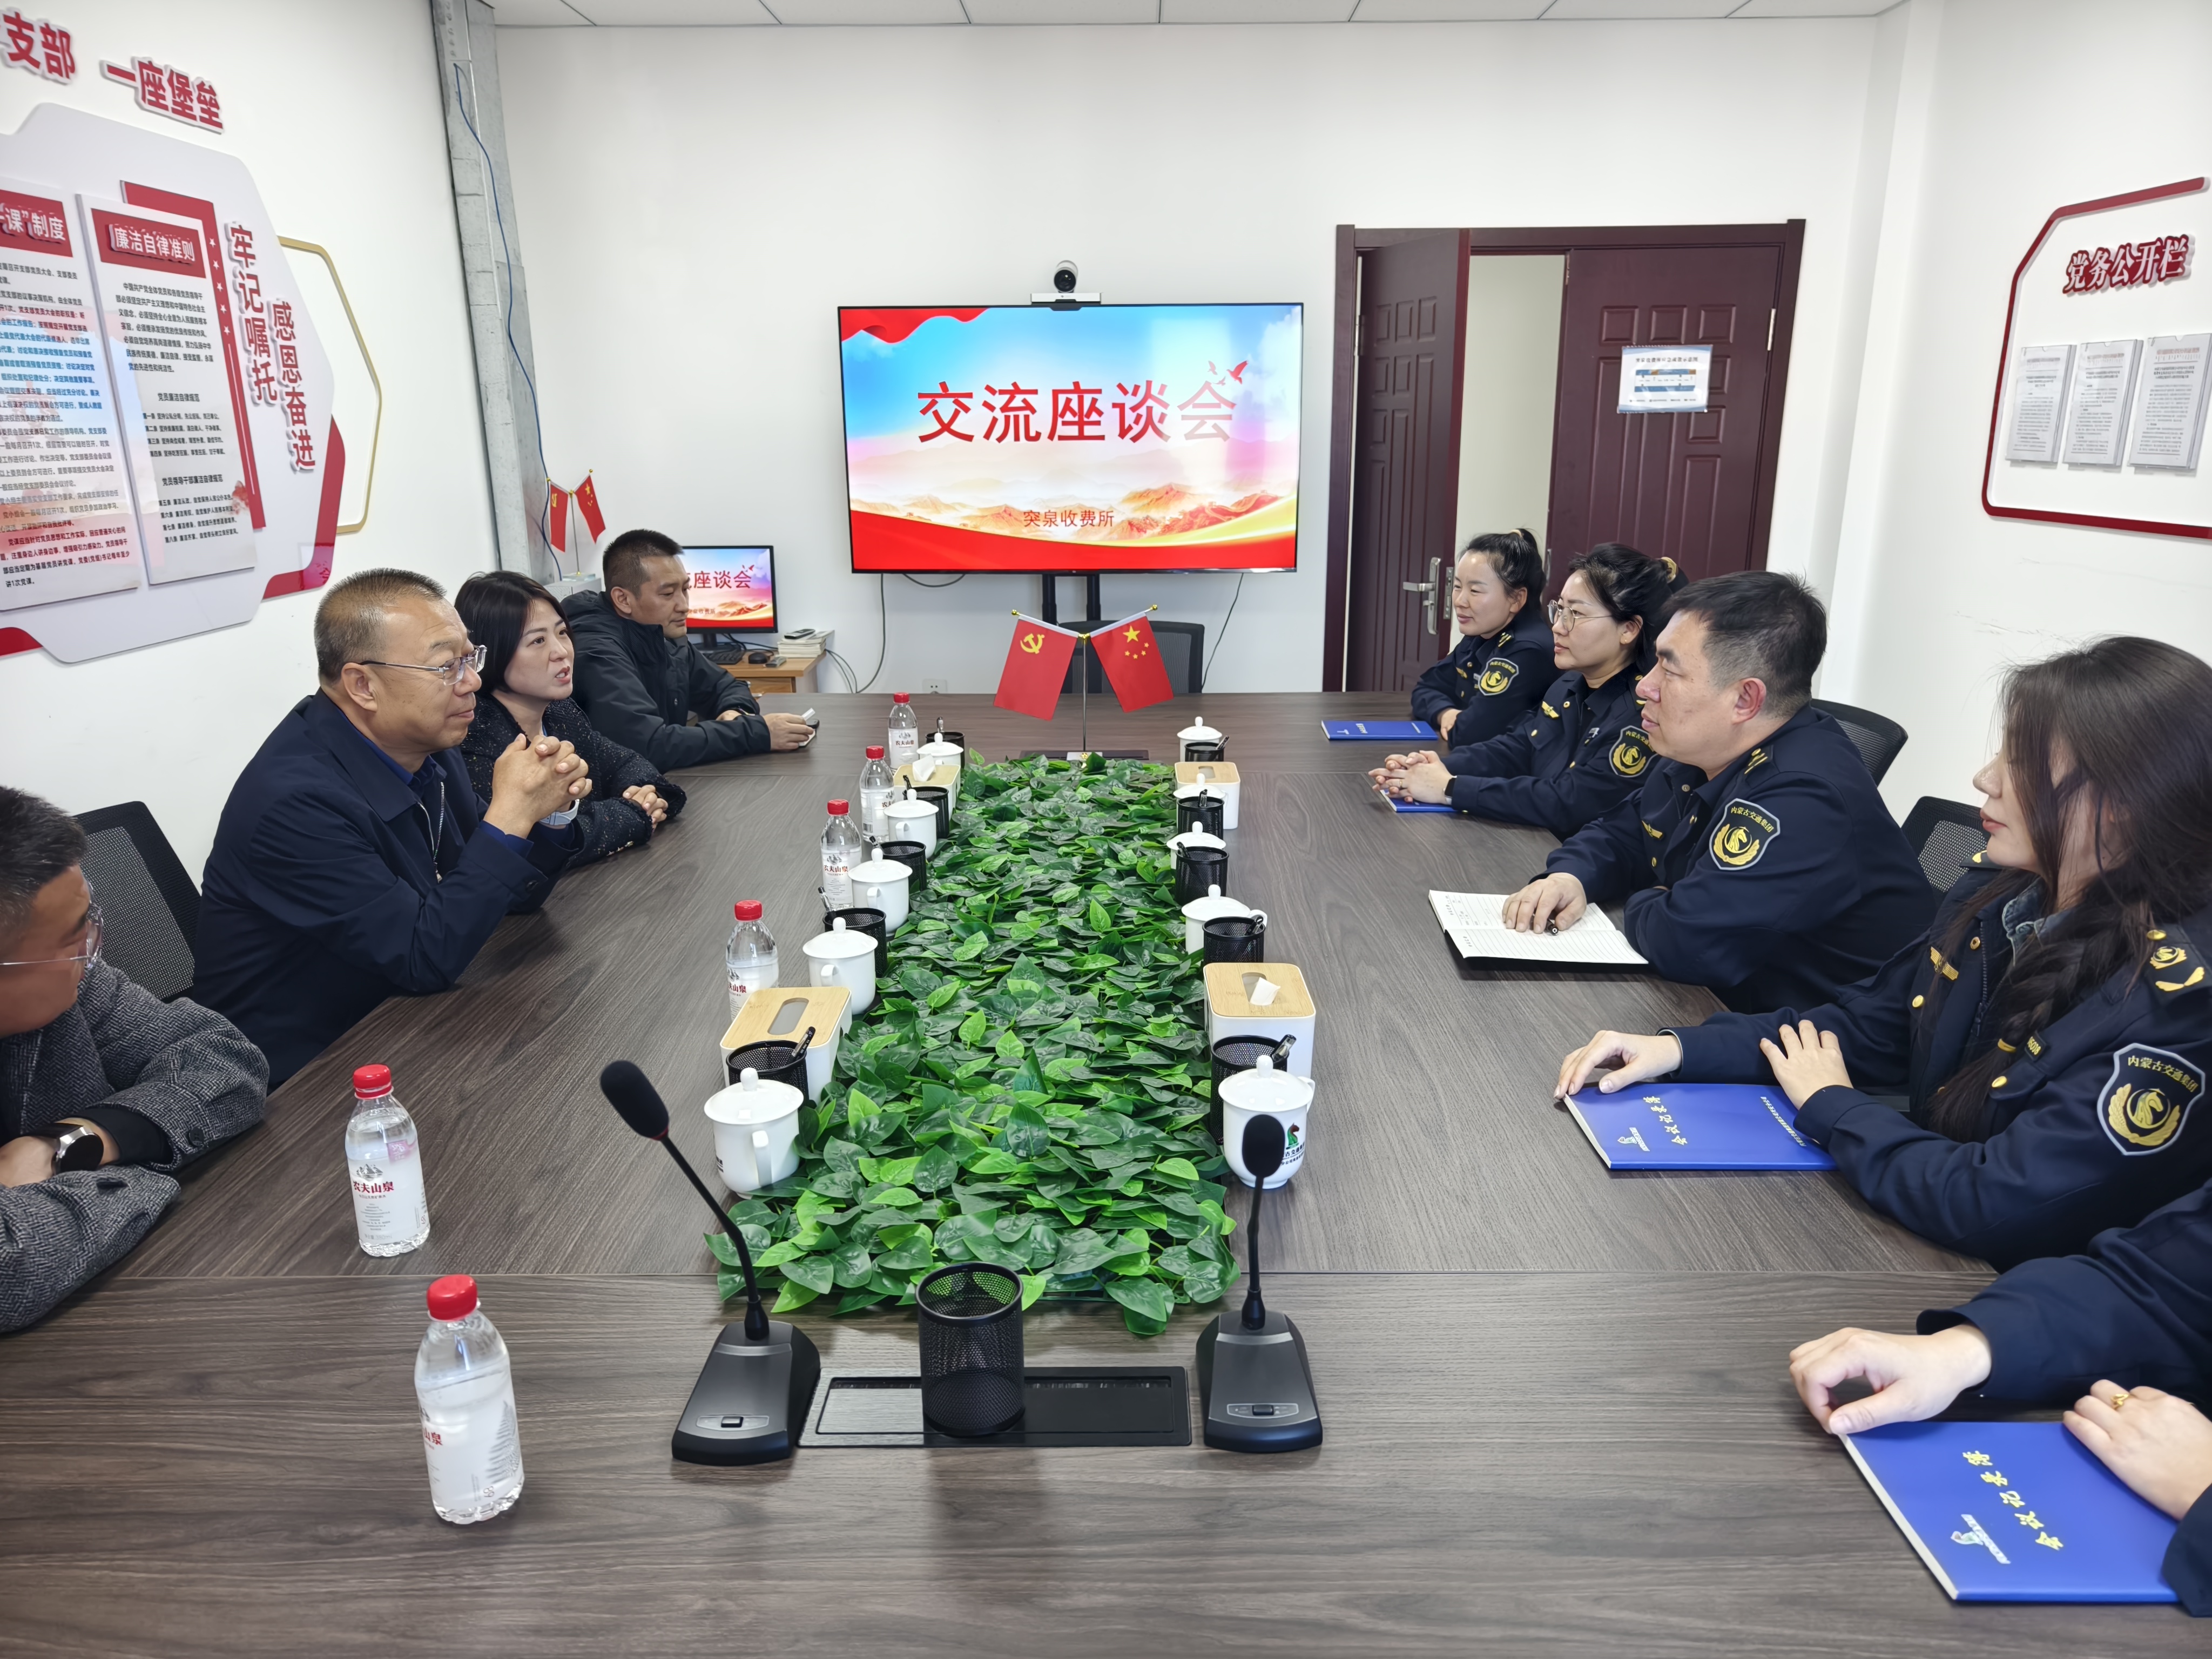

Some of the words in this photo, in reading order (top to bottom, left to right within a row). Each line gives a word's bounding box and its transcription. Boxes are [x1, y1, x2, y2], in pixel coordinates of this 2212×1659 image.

[3, 12, 75, 79] 支部
[106, 60, 223, 130] 一座堡垒
[0, 207, 66, 241] 课”制度
[114, 227, 195, 261] 廉洁自律准则
[2064, 238, 2187, 291] 党务公开栏
[230, 224, 278, 403] 牢记嘱托
[272, 300, 316, 469] 感恩奋进
[917, 380, 1237, 443] 交流座谈会
[1022, 509, 1115, 529] 突泉收费所
[1731, 806, 1774, 833] 内蒙古交通集团
[824, 865, 848, 873] 农夫山泉
[2128, 1055, 2198, 1092] 内蒙古交通集团
[353, 1181, 394, 1193] 农夫山泉
